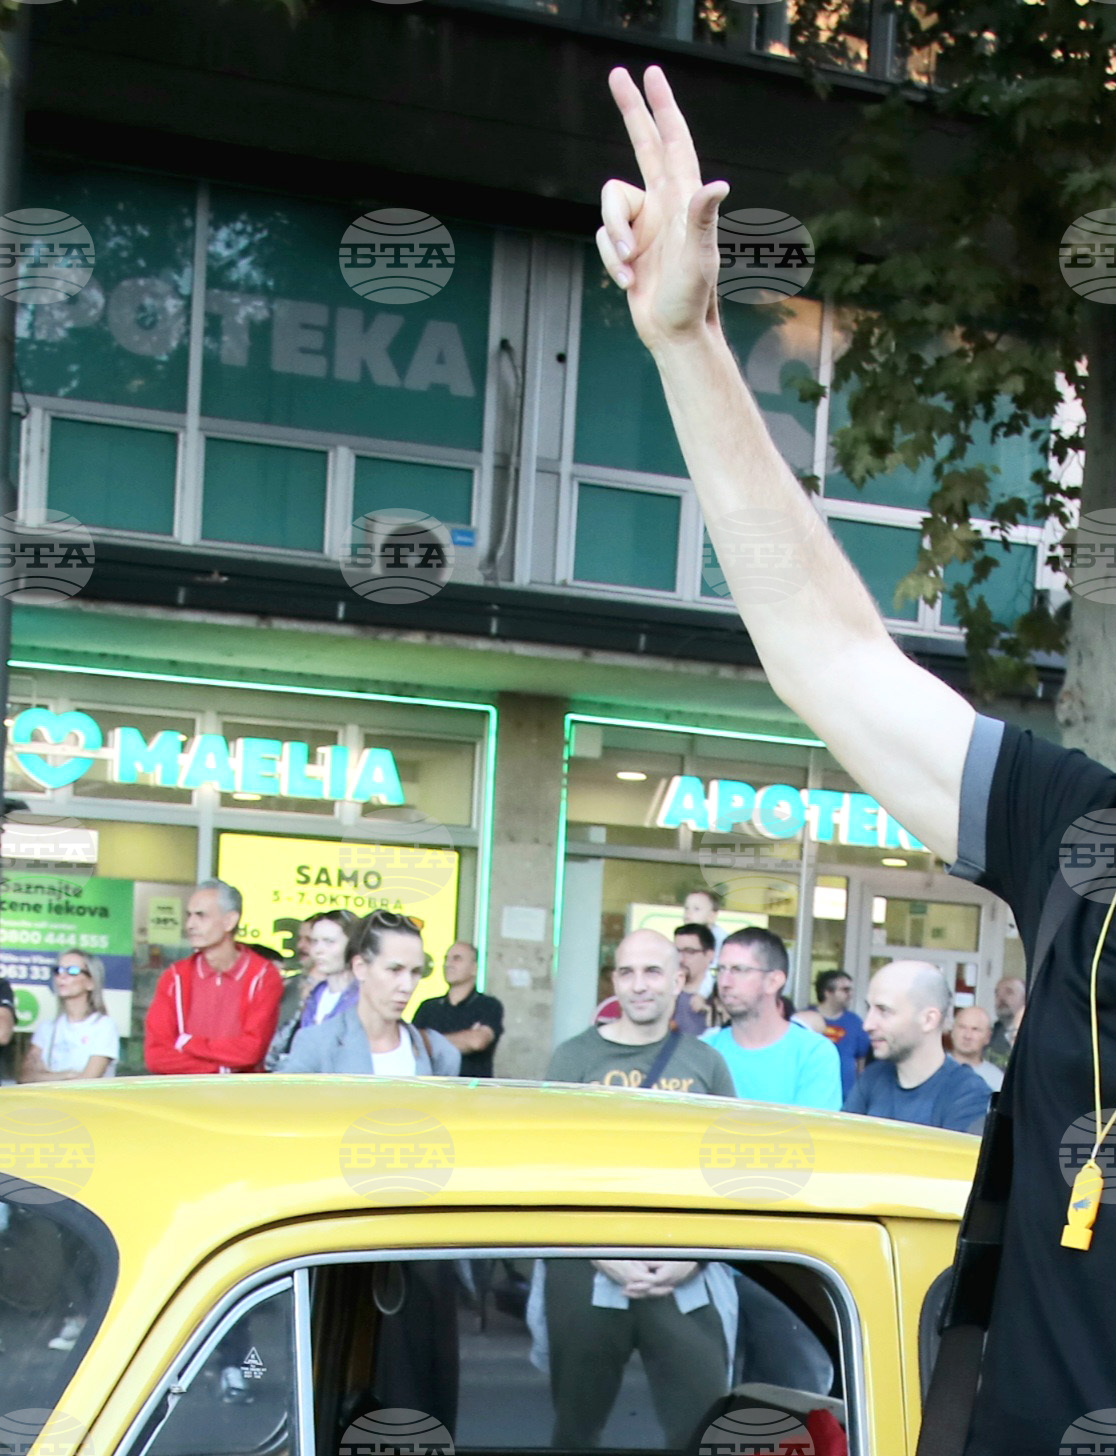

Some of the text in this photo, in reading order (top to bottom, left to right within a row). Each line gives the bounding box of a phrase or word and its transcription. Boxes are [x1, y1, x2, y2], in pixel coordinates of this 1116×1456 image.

[113, 726, 405, 806] MAELIA
[296, 864, 383, 890] SAMO
[314, 893, 404, 910] OKTOBRA
